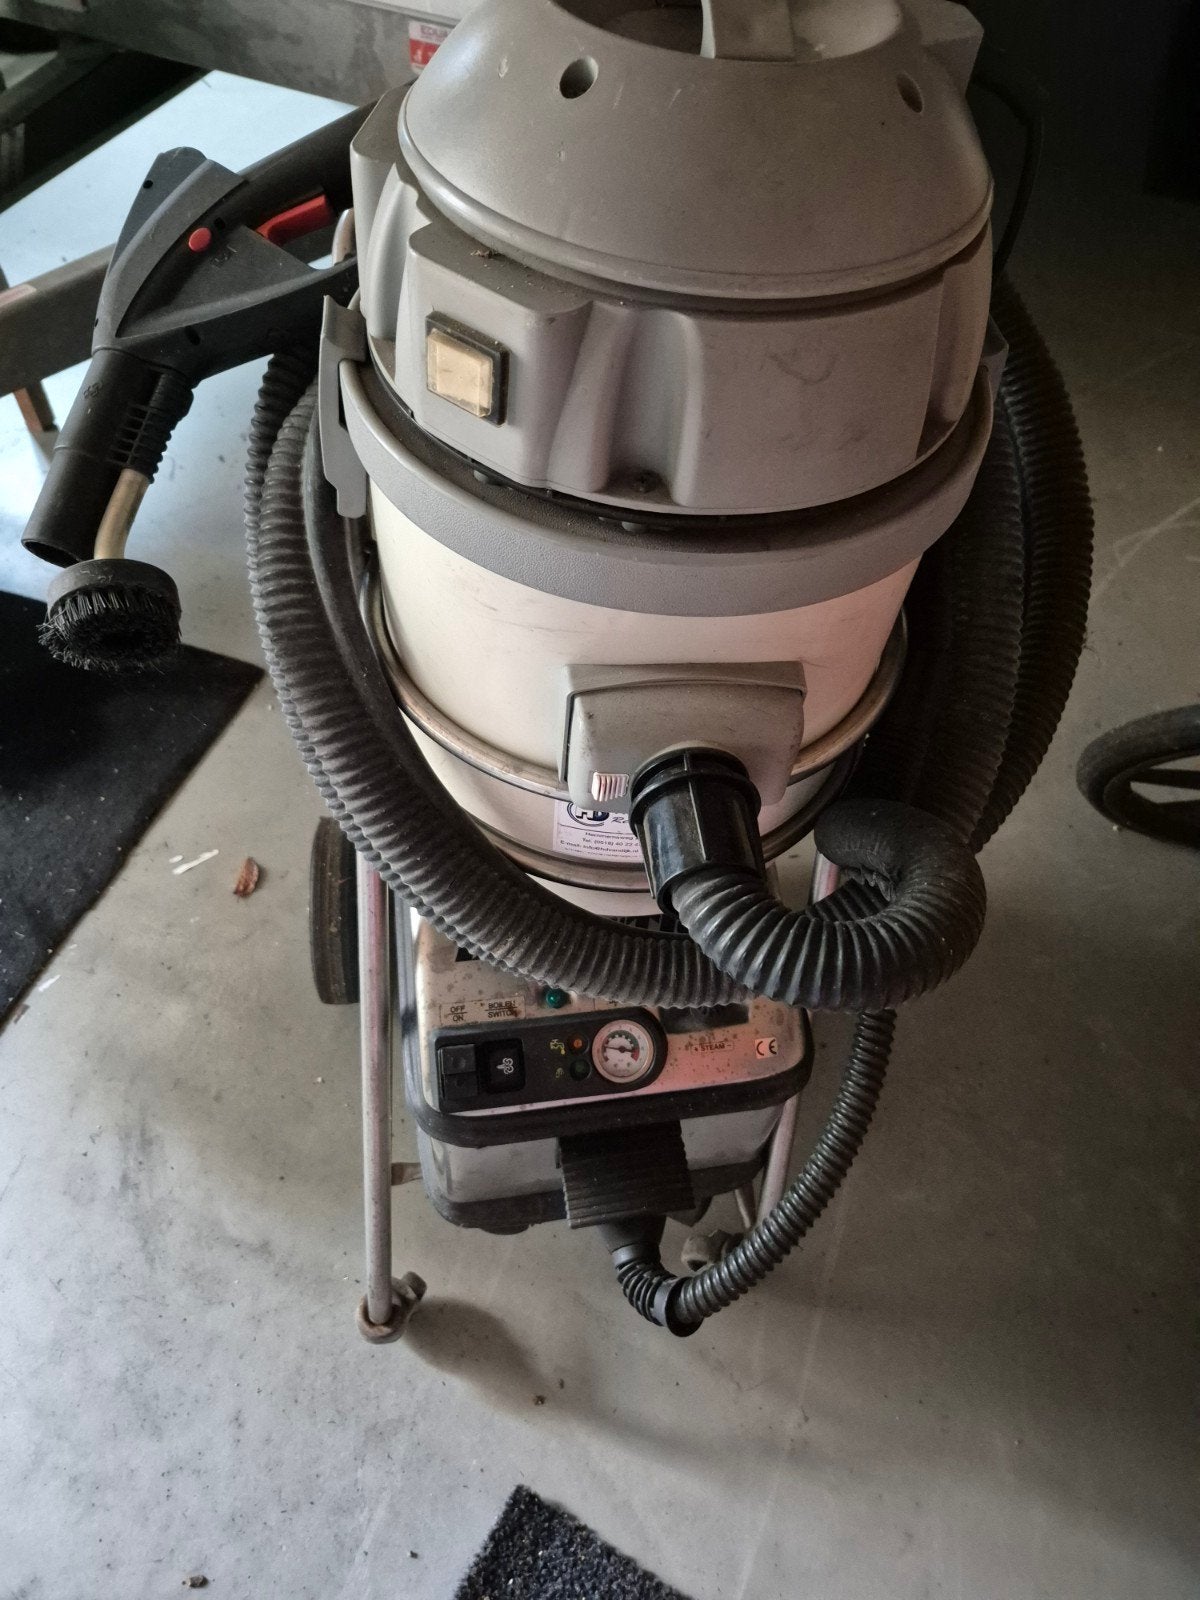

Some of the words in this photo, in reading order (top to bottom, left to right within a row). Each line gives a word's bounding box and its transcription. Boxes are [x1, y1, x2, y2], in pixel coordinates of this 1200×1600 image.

[450, 1005, 466, 1013] OFF
[452, 1014, 464, 1022] ON
[700, 1043, 725, 1051] STEAM
[756, 1039, 777, 1056] CE
